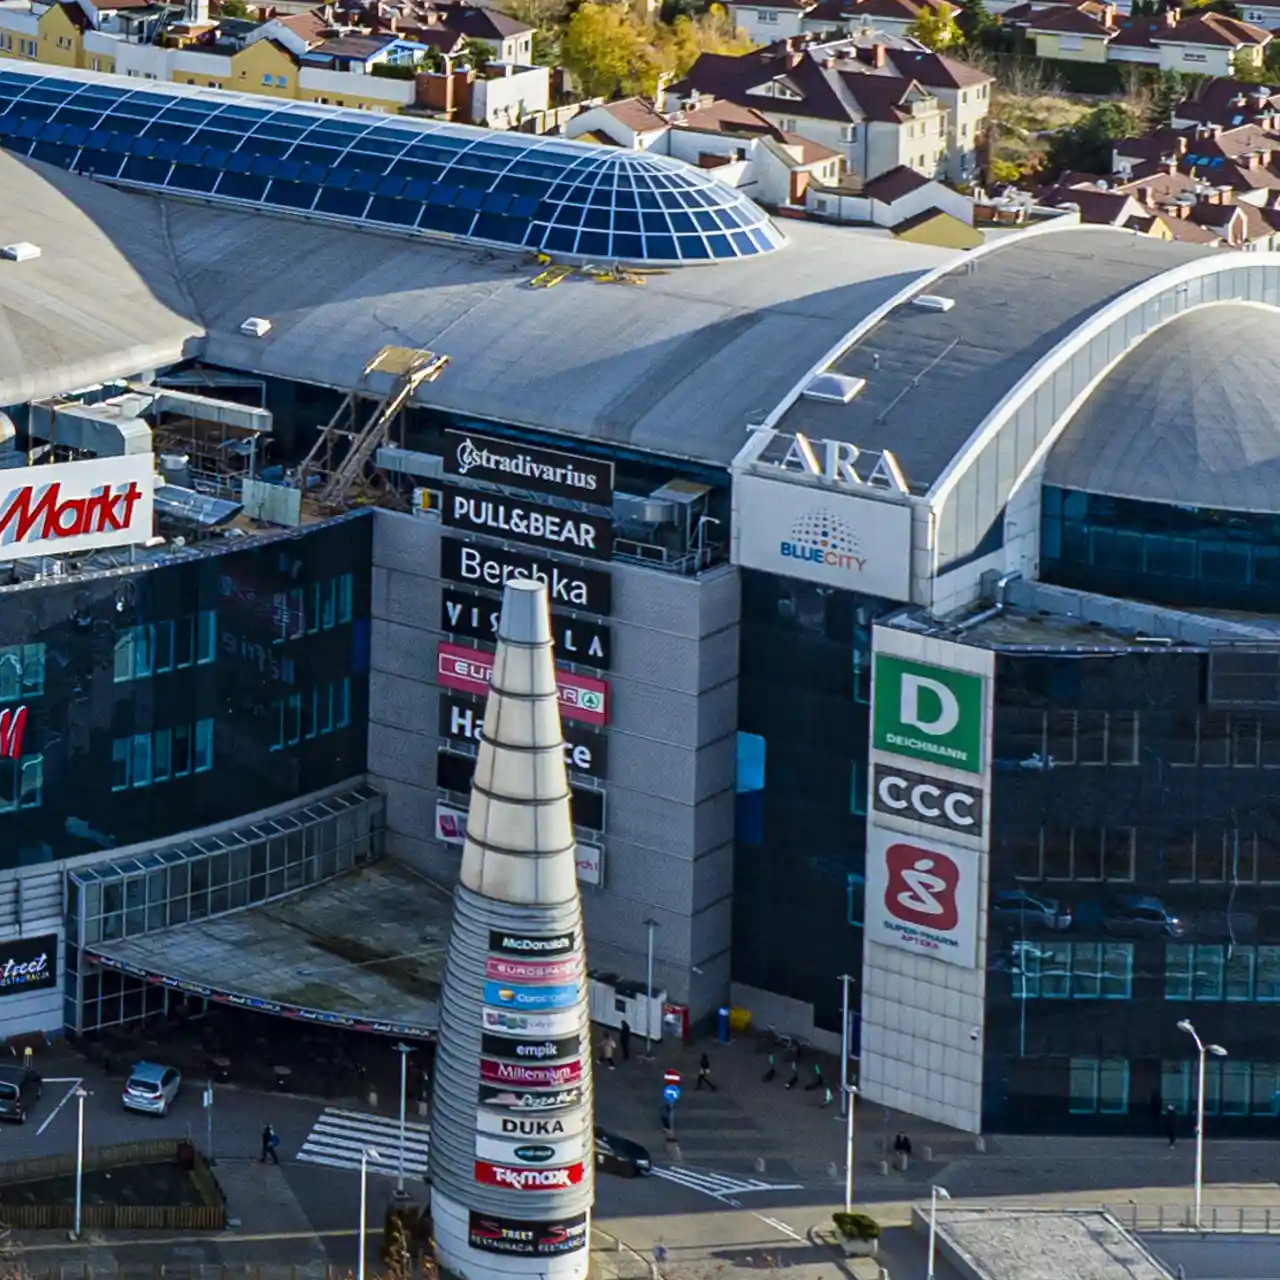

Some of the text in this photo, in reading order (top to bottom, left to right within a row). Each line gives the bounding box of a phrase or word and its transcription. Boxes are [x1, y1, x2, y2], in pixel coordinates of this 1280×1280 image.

[453, 495, 597, 550] PULL&BEAR
[885, 732, 968, 762] DEICHMANN
[878, 775, 976, 826] CCC
[516, 1042, 558, 1058] empik
[501, 1118, 565, 1135] DUKA
